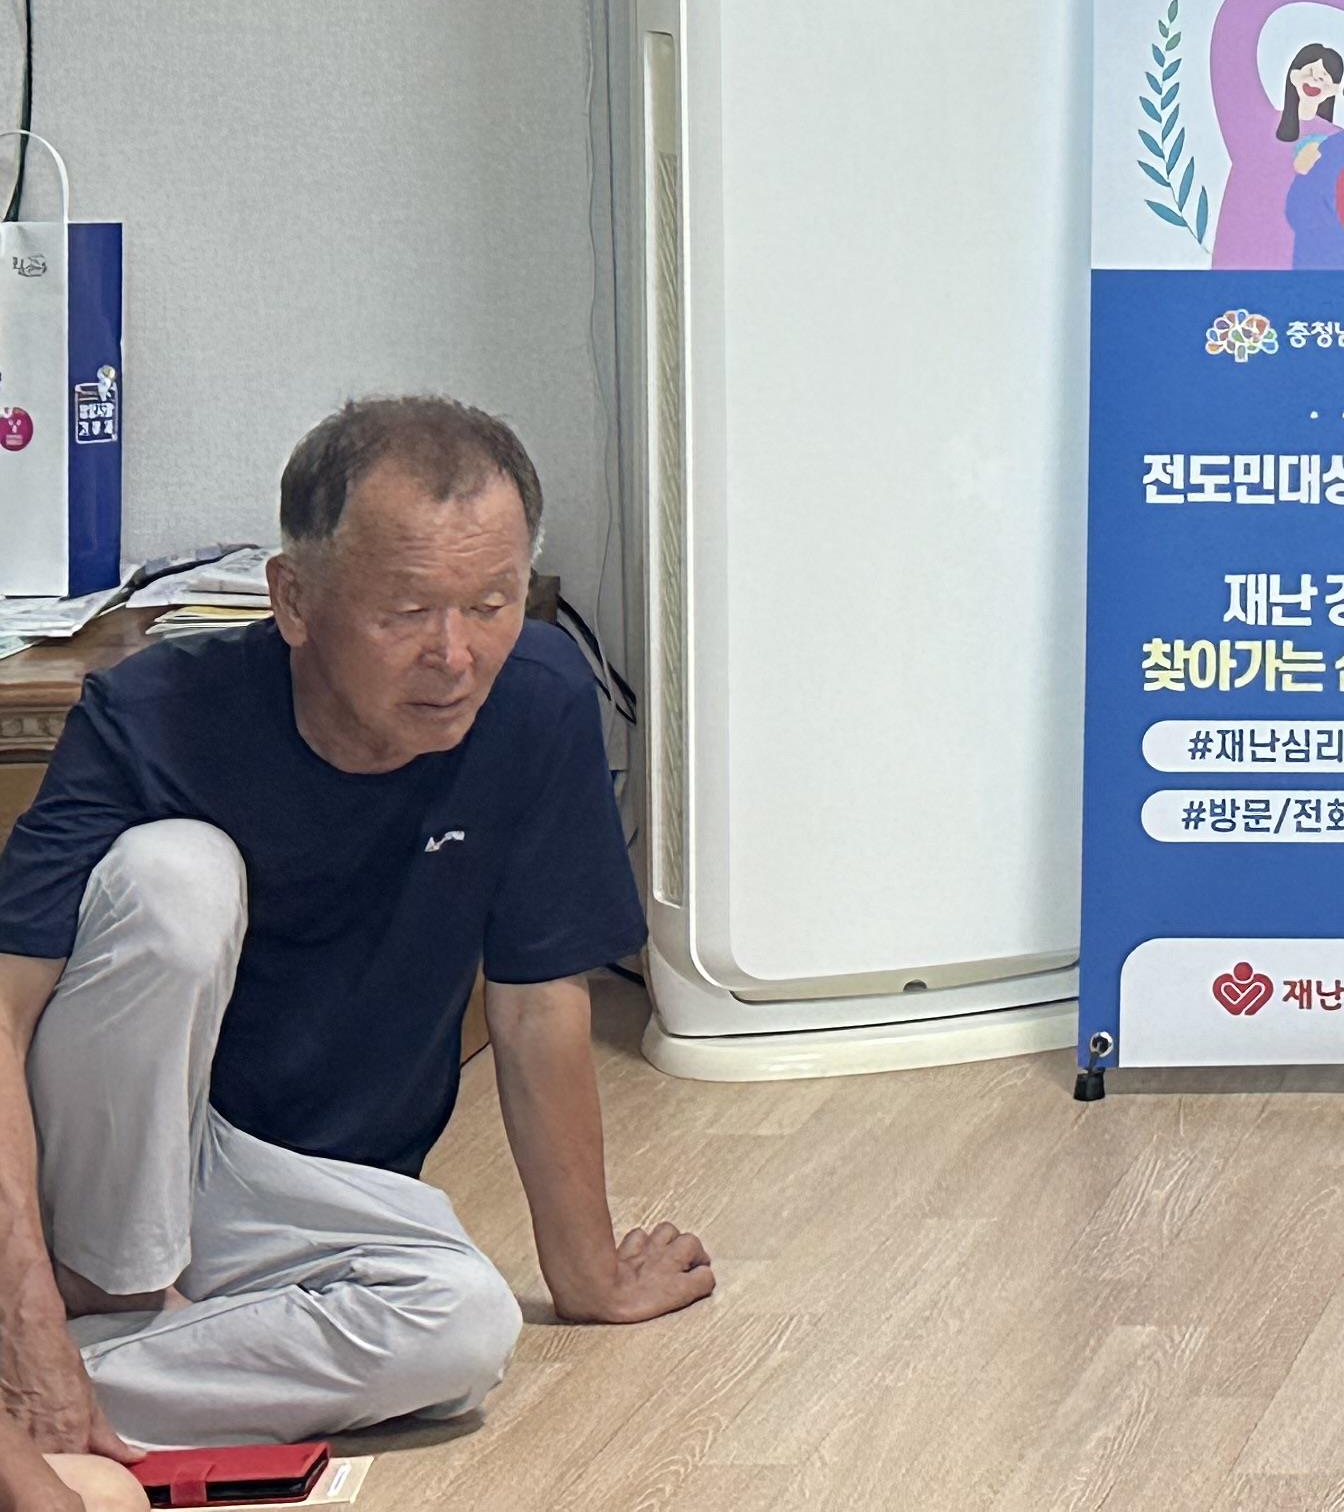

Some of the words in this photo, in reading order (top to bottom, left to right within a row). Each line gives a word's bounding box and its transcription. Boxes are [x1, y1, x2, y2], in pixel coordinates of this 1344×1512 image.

[1223, 574, 1317, 627] 재난
[1141, 638, 1327, 693] 찾아가는
[1187, 728, 1344, 764] #재난심리
